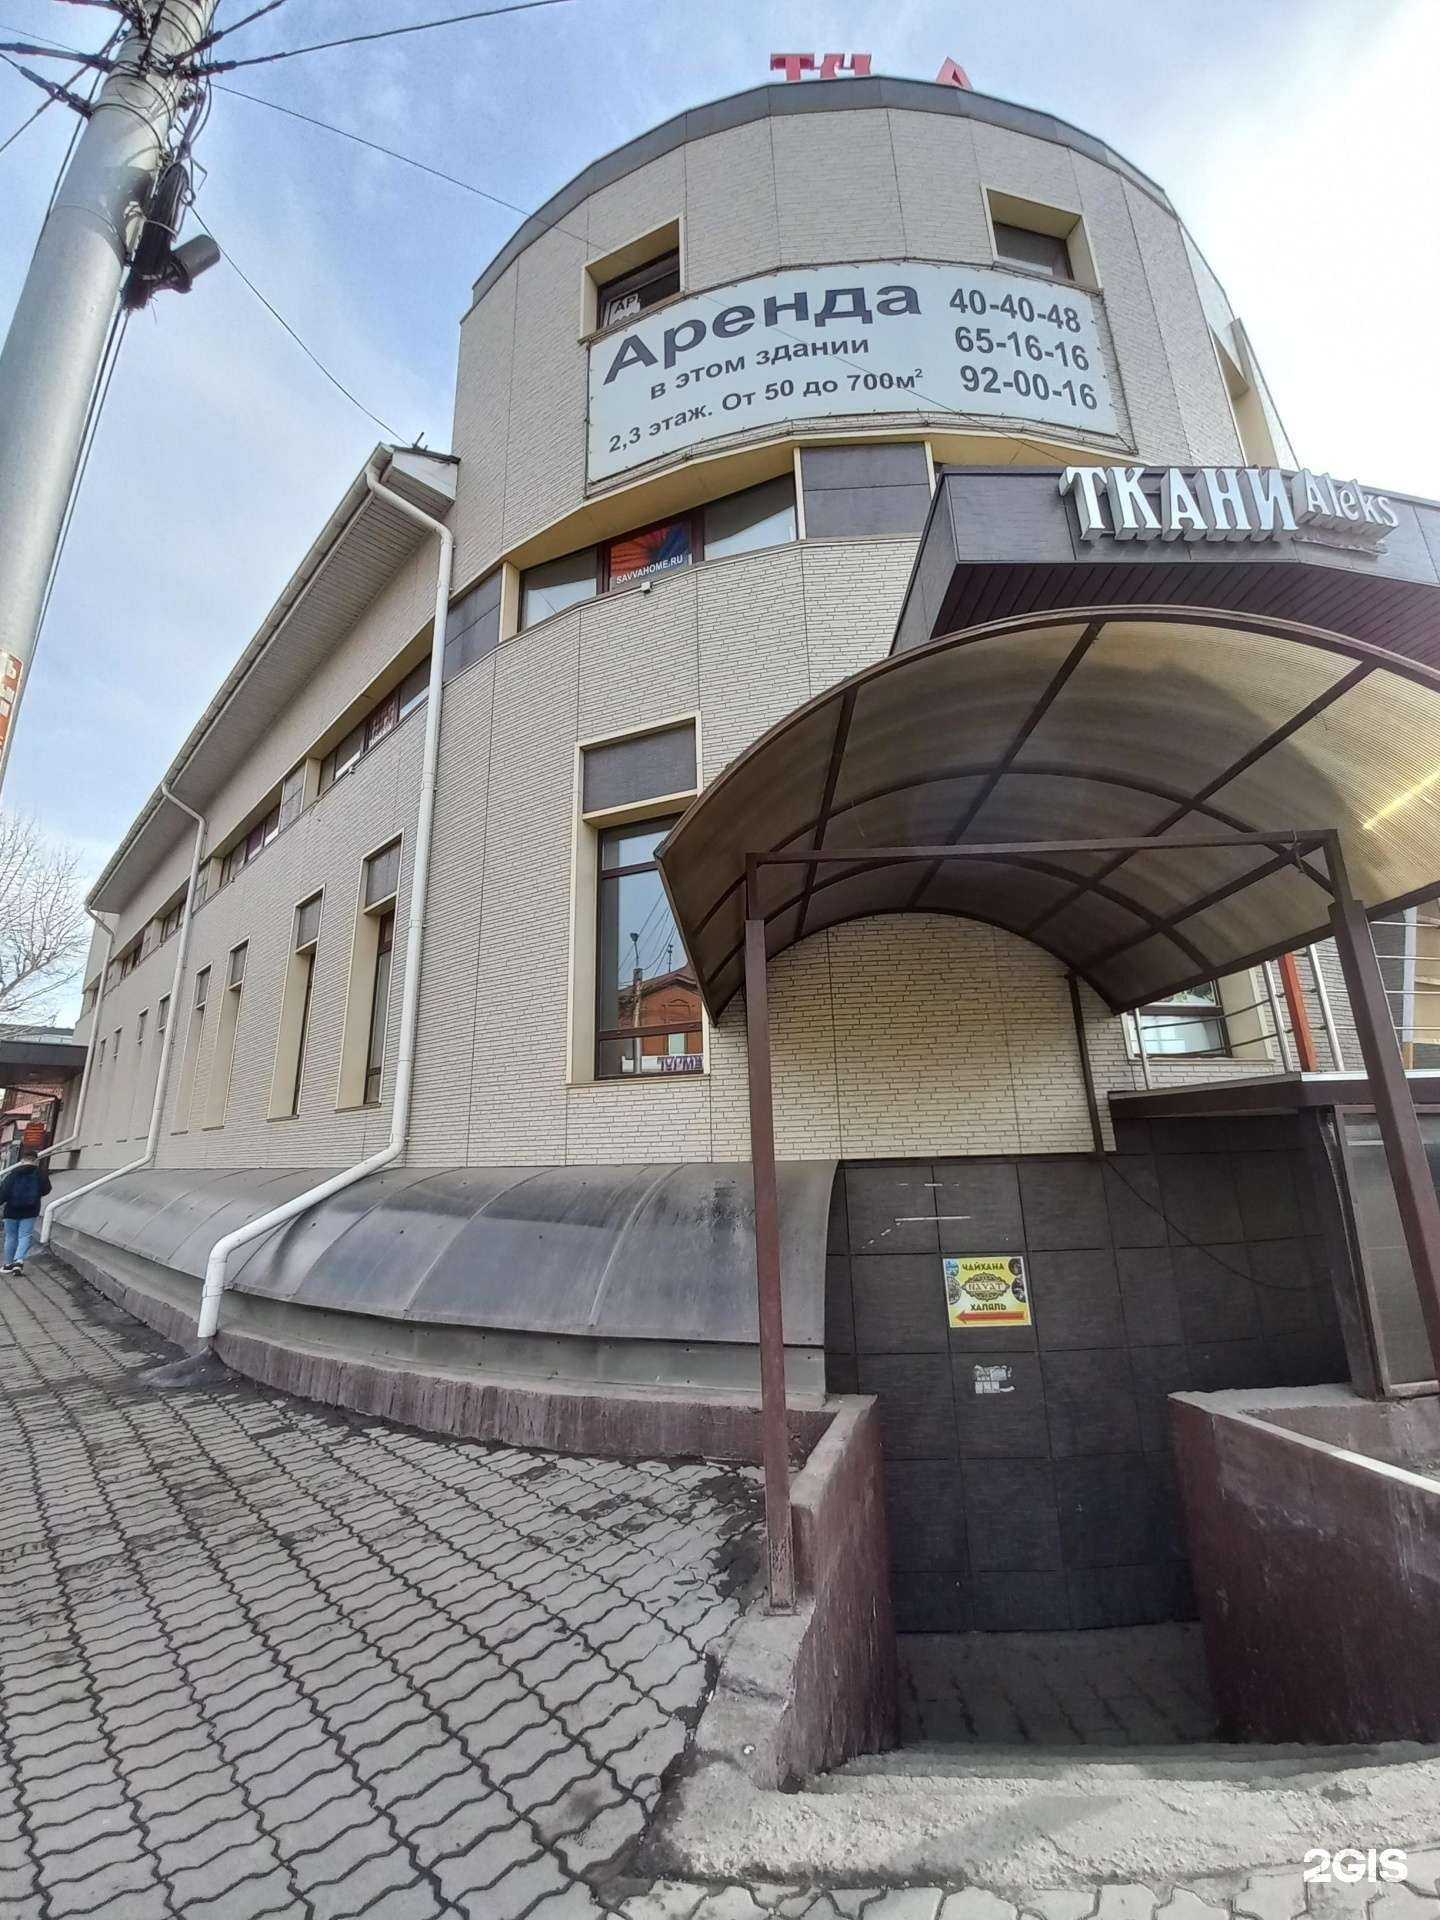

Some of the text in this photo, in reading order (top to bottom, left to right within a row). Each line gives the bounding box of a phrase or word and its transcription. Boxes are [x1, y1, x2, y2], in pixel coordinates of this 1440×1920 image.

[602, 284, 923, 386] Аренда
[949, 287, 1082, 334] 40-40-48
[650, 338, 870, 400] в этом здании
[954, 326, 1091, 372] 65-16-16
[959, 364, 1099, 411] 92-00-16
[608, 426, 642, 454] 2,3
[648, 404, 714, 437] этаж.
[721, 392, 757, 412] От
[764, 379, 795, 402] 50
[802, 379, 839, 398] до
[1061, 465, 1300, 537] ТКАНИ
[1300, 468, 1400, 527] Aleks
[615, 554, 684, 584] SAVVAHOME.RU
[961, 1261, 1005, 1271] ЧАЙХАНА
